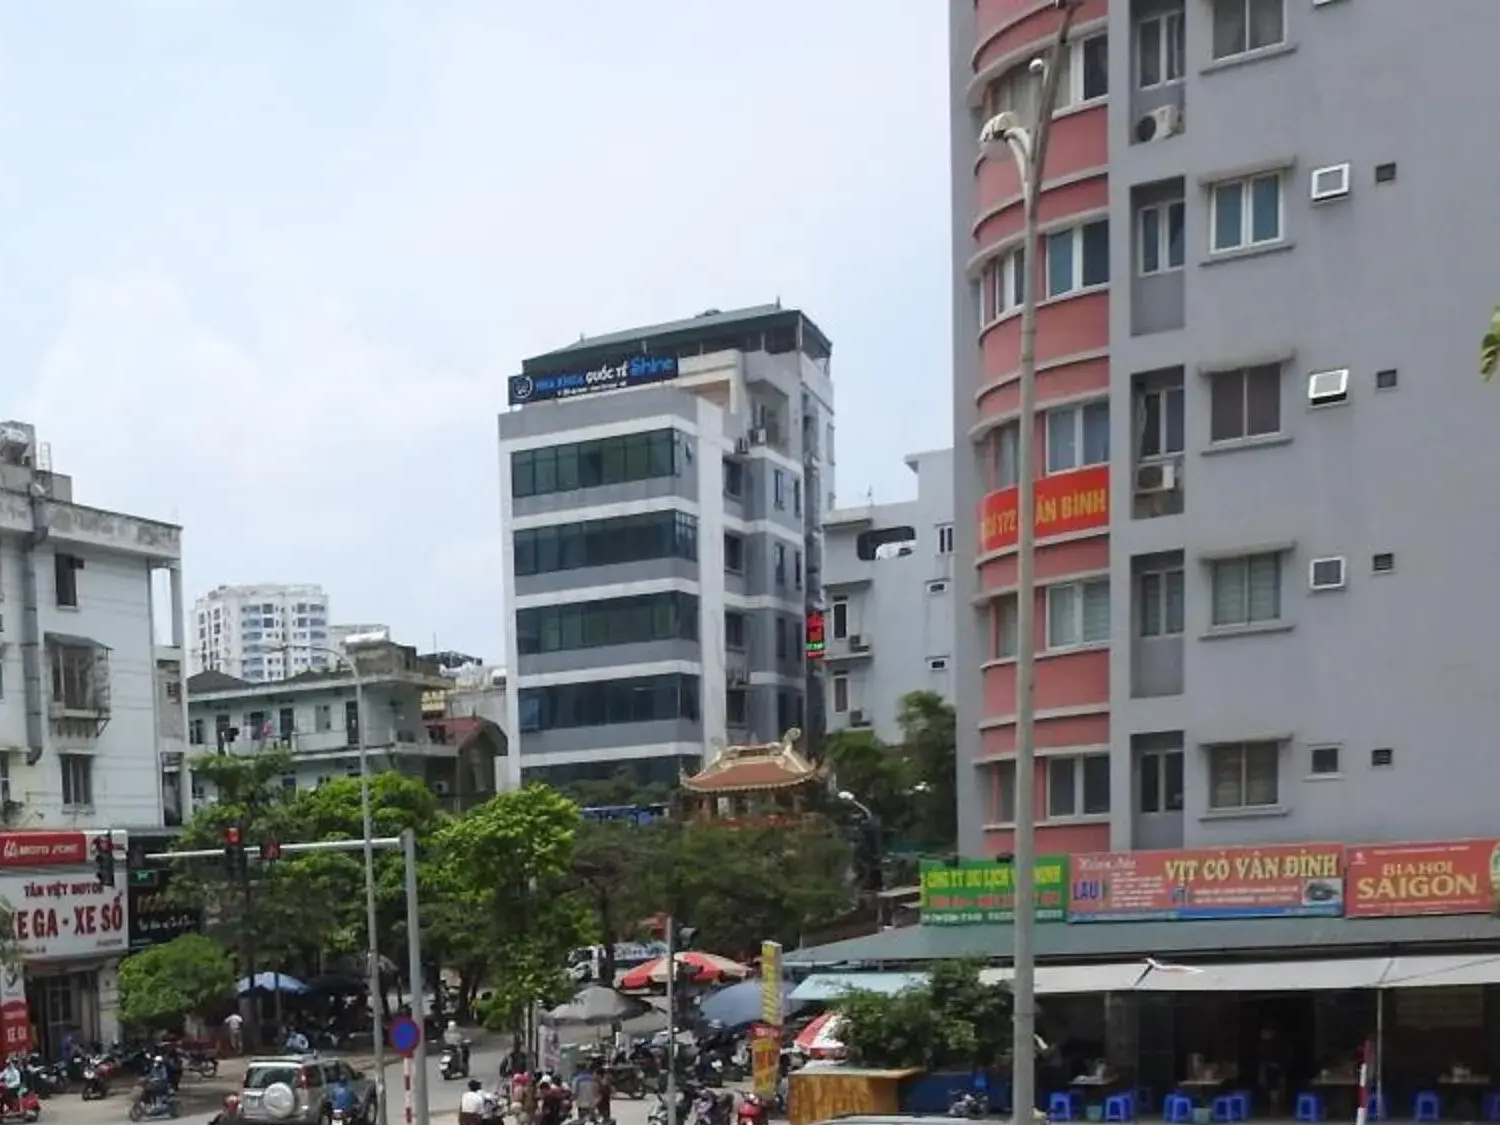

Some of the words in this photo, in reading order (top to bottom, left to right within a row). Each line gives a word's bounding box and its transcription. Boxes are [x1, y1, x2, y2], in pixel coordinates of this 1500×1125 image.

[1357, 874, 1478, 900] SAIGON
[32, 907, 58, 938] GA
[74, 905, 96, 935] XE
[100, 889, 123, 932] SỐ
